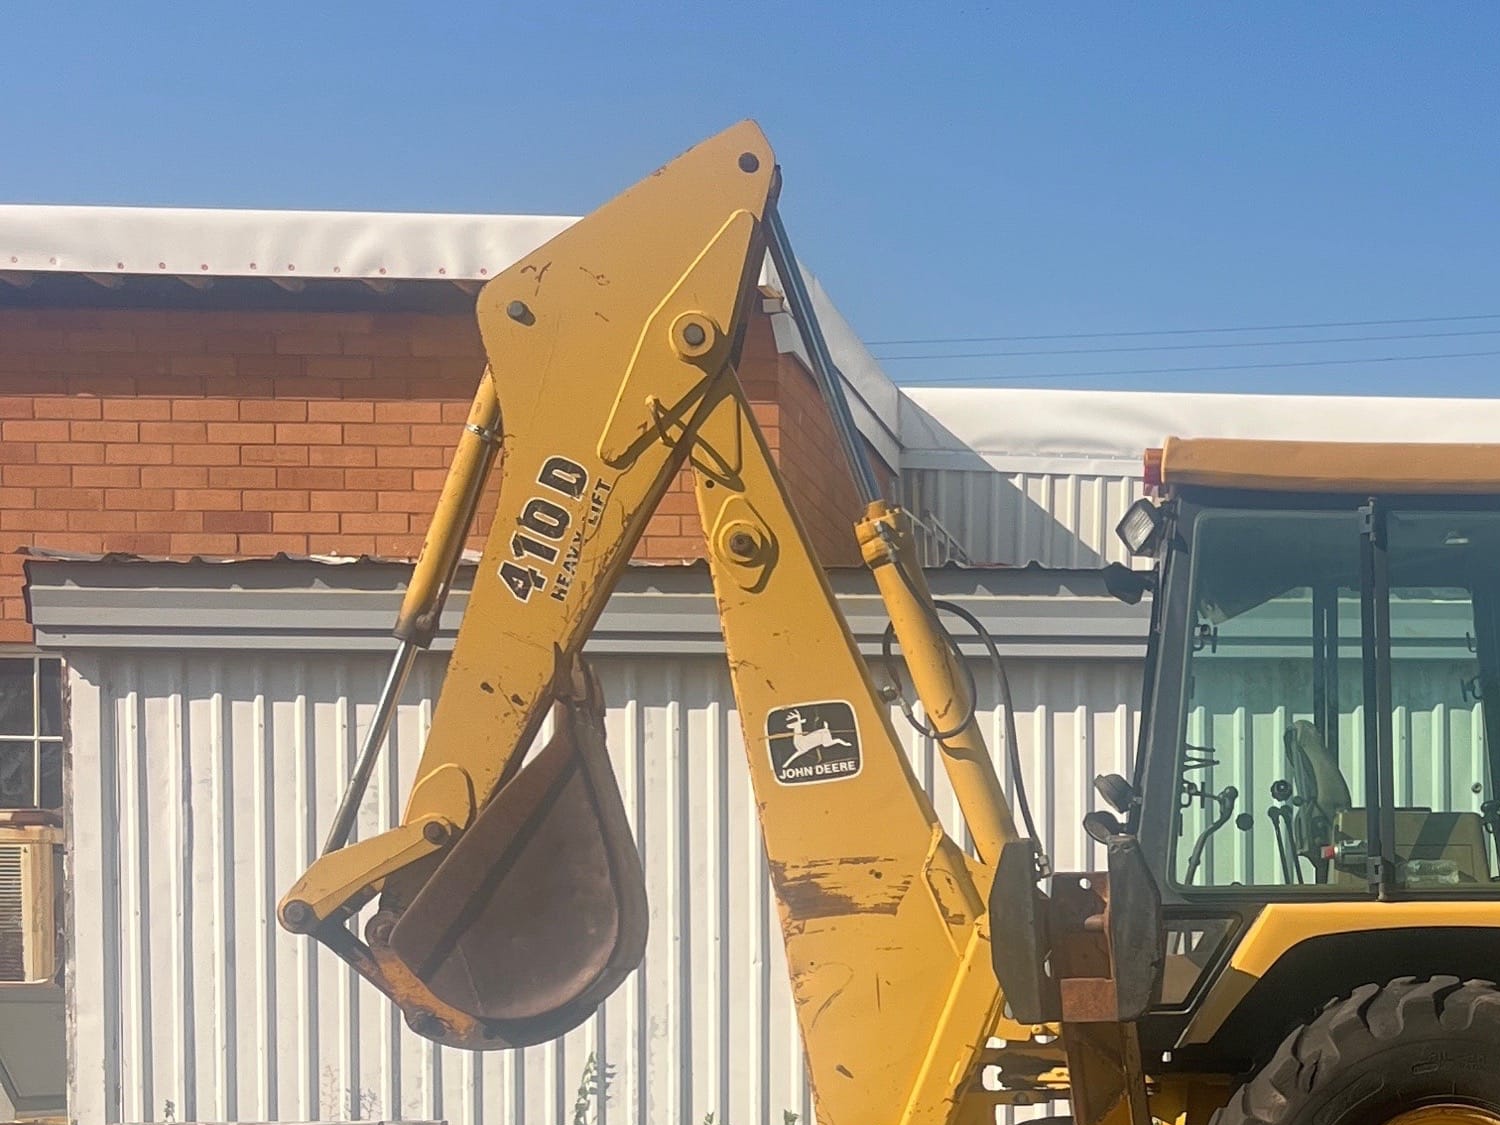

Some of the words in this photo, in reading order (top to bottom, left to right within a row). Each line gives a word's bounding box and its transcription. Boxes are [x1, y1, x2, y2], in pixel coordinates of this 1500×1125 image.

[498, 496, 572, 604] 410
[537, 456, 589, 501] D
[551, 530, 582, 602] HEAVY
[587, 478, 612, 528] LIFT
[779, 765, 813, 780] JOHN
[815, 760, 857, 775] DEERE
